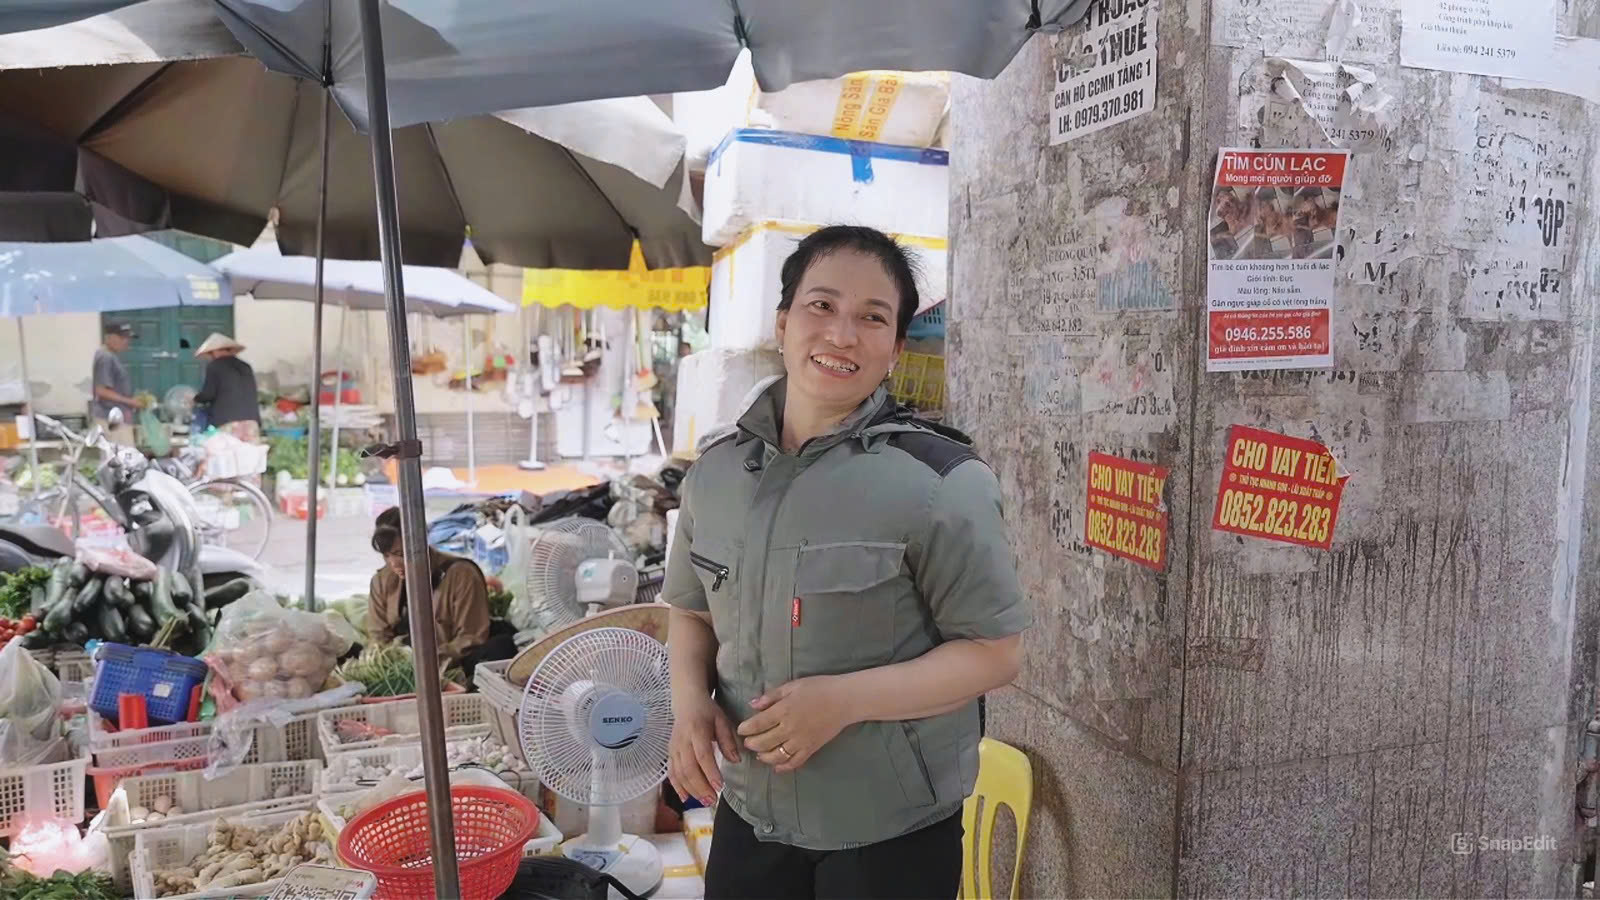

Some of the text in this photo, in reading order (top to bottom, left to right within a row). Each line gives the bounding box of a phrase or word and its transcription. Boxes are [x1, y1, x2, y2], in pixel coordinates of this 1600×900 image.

[1463, 45, 1478, 56] 094
[1480, 46, 1494, 57] 241
[1496, 48, 1516, 60] 5379
[1073, 81, 1086, 104] HỘ
[1088, 72, 1115, 98] CCMN
[1146, 58, 1151, 77] 1
[1058, 88, 1144, 135] LH: 0979.370.981
[1330, 128, 1346, 139] 241
[1348, 129, 1375, 141] 5379
[1224, 153, 1327, 174] TÌM CÚN LẠC
[1225, 172, 1333, 184] Mong mọi người giúp đỡ
[1225, 325, 1311, 341] 0946.255.586
[1231, 437, 1266, 471] CHO
[1271, 445, 1302, 479] VAY
[1090, 462, 1112, 493] CHO
[1114, 468, 1135, 498] VAY
[1219, 488, 1332, 543] 0852.823.283
[1087, 507, 1161, 564] 0852.823.283
[602, 716, 633, 724] SENKO
